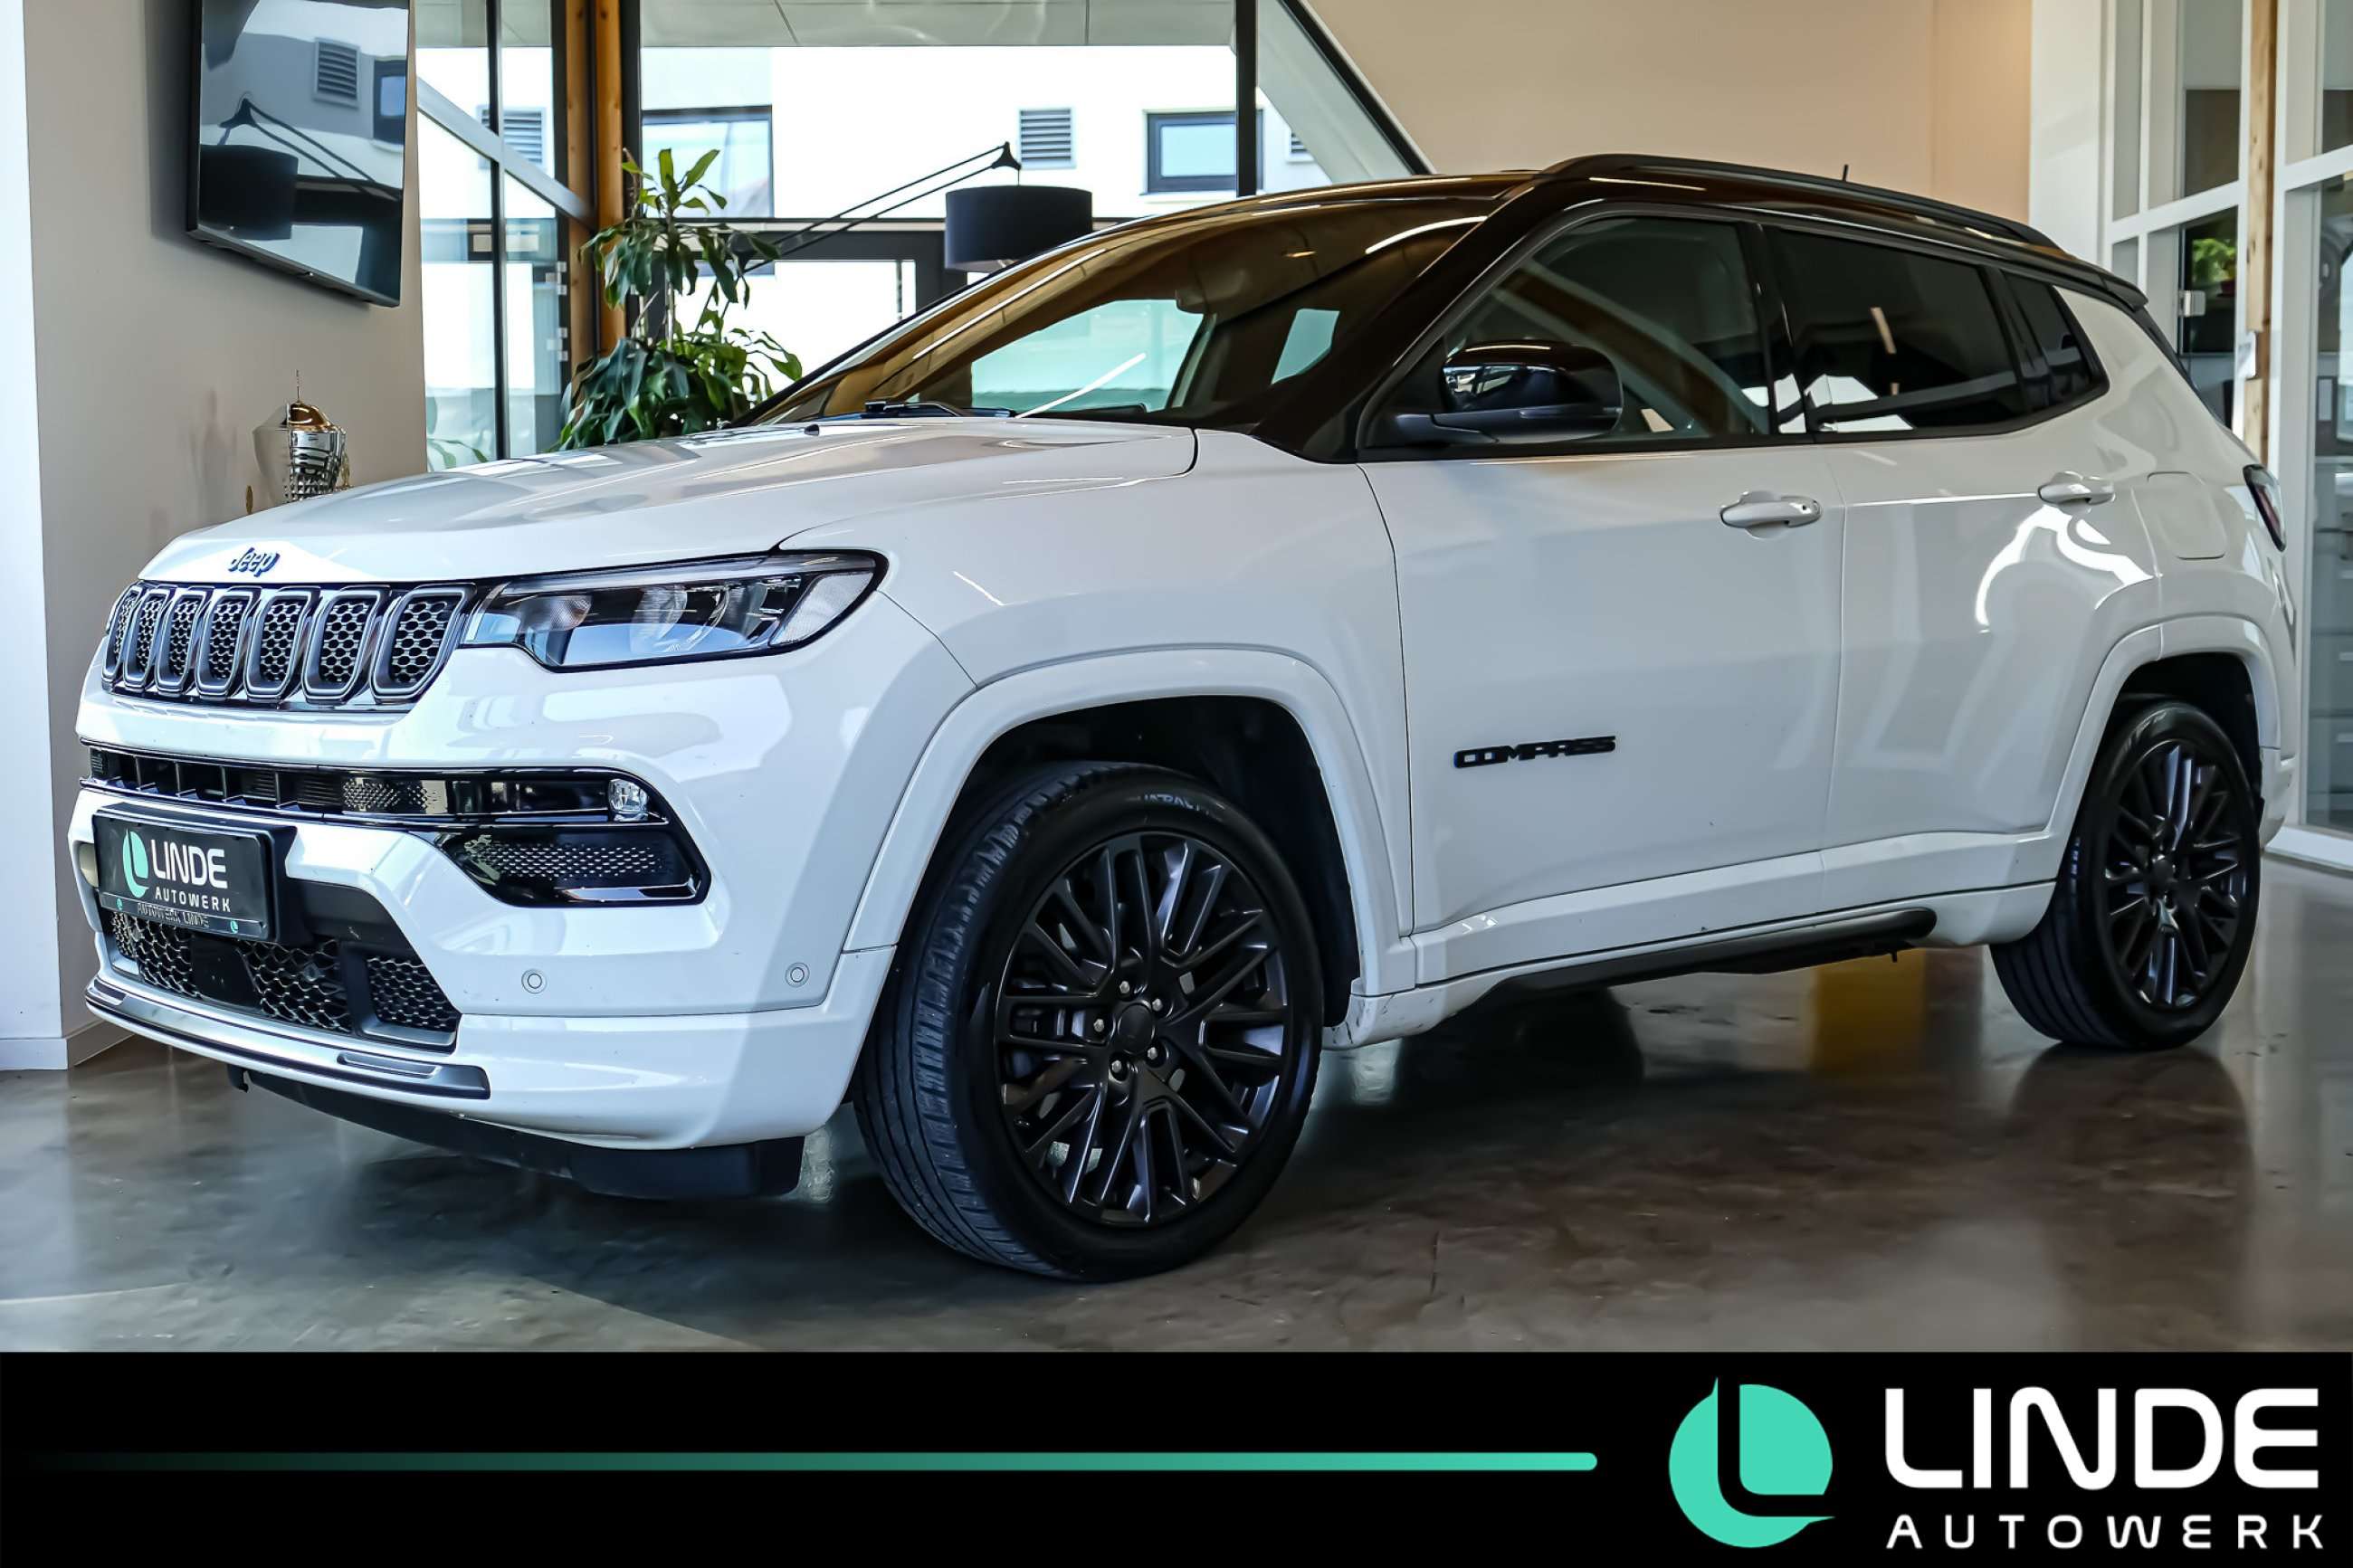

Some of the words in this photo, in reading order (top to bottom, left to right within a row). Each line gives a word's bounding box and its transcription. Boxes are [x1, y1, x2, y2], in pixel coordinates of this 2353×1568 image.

[227, 546, 281, 578] Jeep
[1453, 736, 1616, 769] COMPASS
[150, 839, 228, 888] LINDE
[155, 887, 231, 913] AUTOWERK
